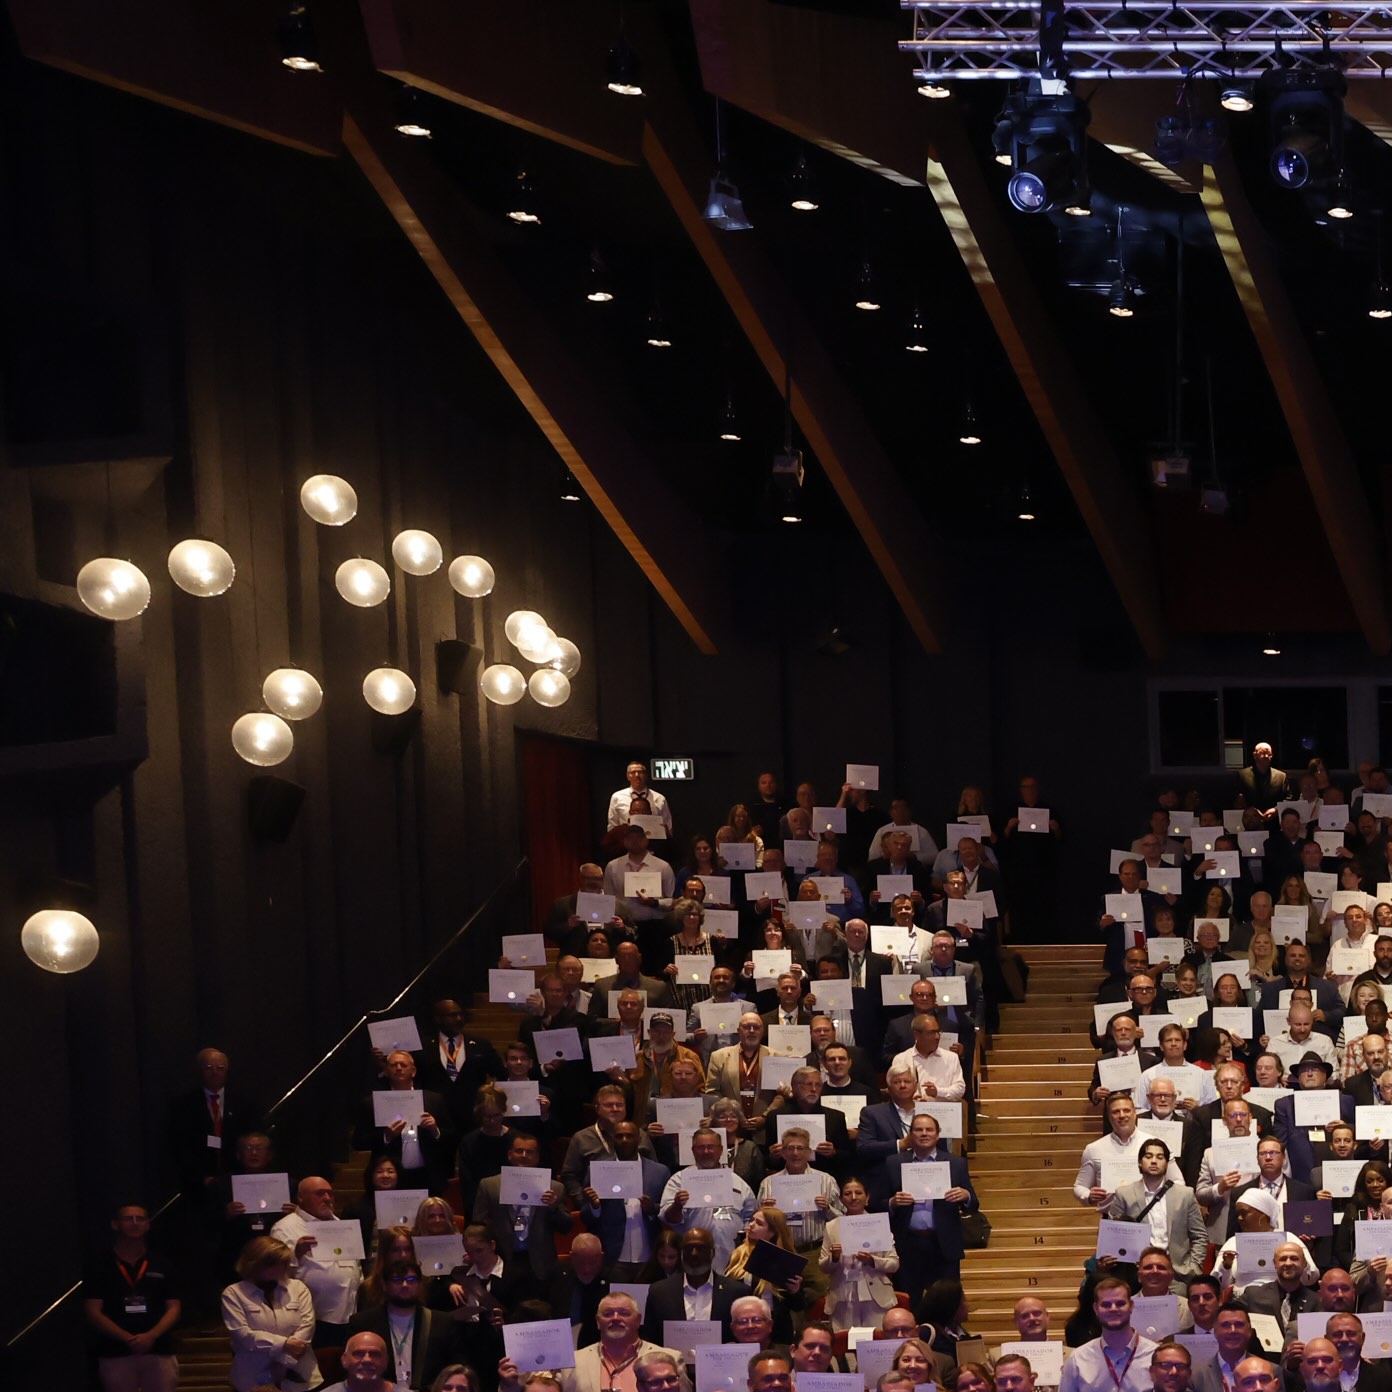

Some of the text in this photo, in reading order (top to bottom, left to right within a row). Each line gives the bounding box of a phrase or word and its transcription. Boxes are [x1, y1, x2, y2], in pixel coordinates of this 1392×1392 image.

[655, 761, 689, 778] יציאה
[1050, 1125, 1058, 1133] 17
[1044, 1159, 1053, 1167] 16
[1039, 1197, 1049, 1205] 15
[1034, 1237, 1044, 1245] 14
[1028, 1278, 1038, 1286] 13
